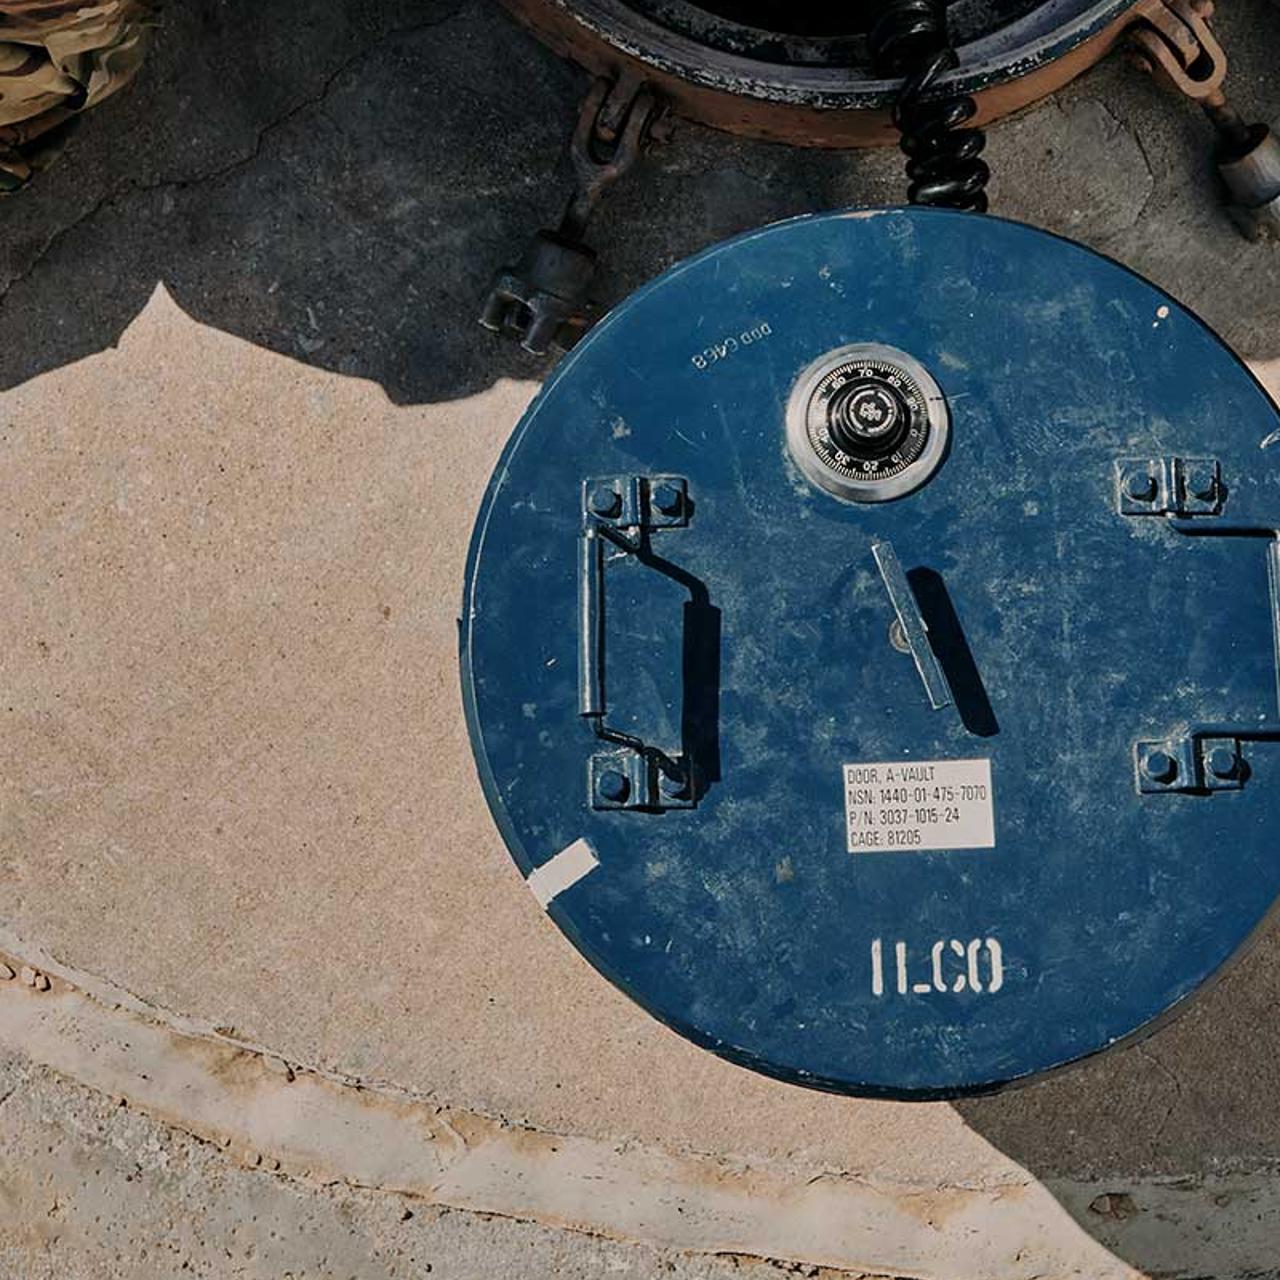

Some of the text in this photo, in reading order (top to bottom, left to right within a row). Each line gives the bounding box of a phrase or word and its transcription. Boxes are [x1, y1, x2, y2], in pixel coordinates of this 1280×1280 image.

[886, 766, 935, 782] A-VAULT
[848, 784, 987, 805] NSN: 1440-01-475-7070
[849, 807, 960, 825] P/N: 3037-1015-24
[850, 829, 921, 847] CAGE: 81205
